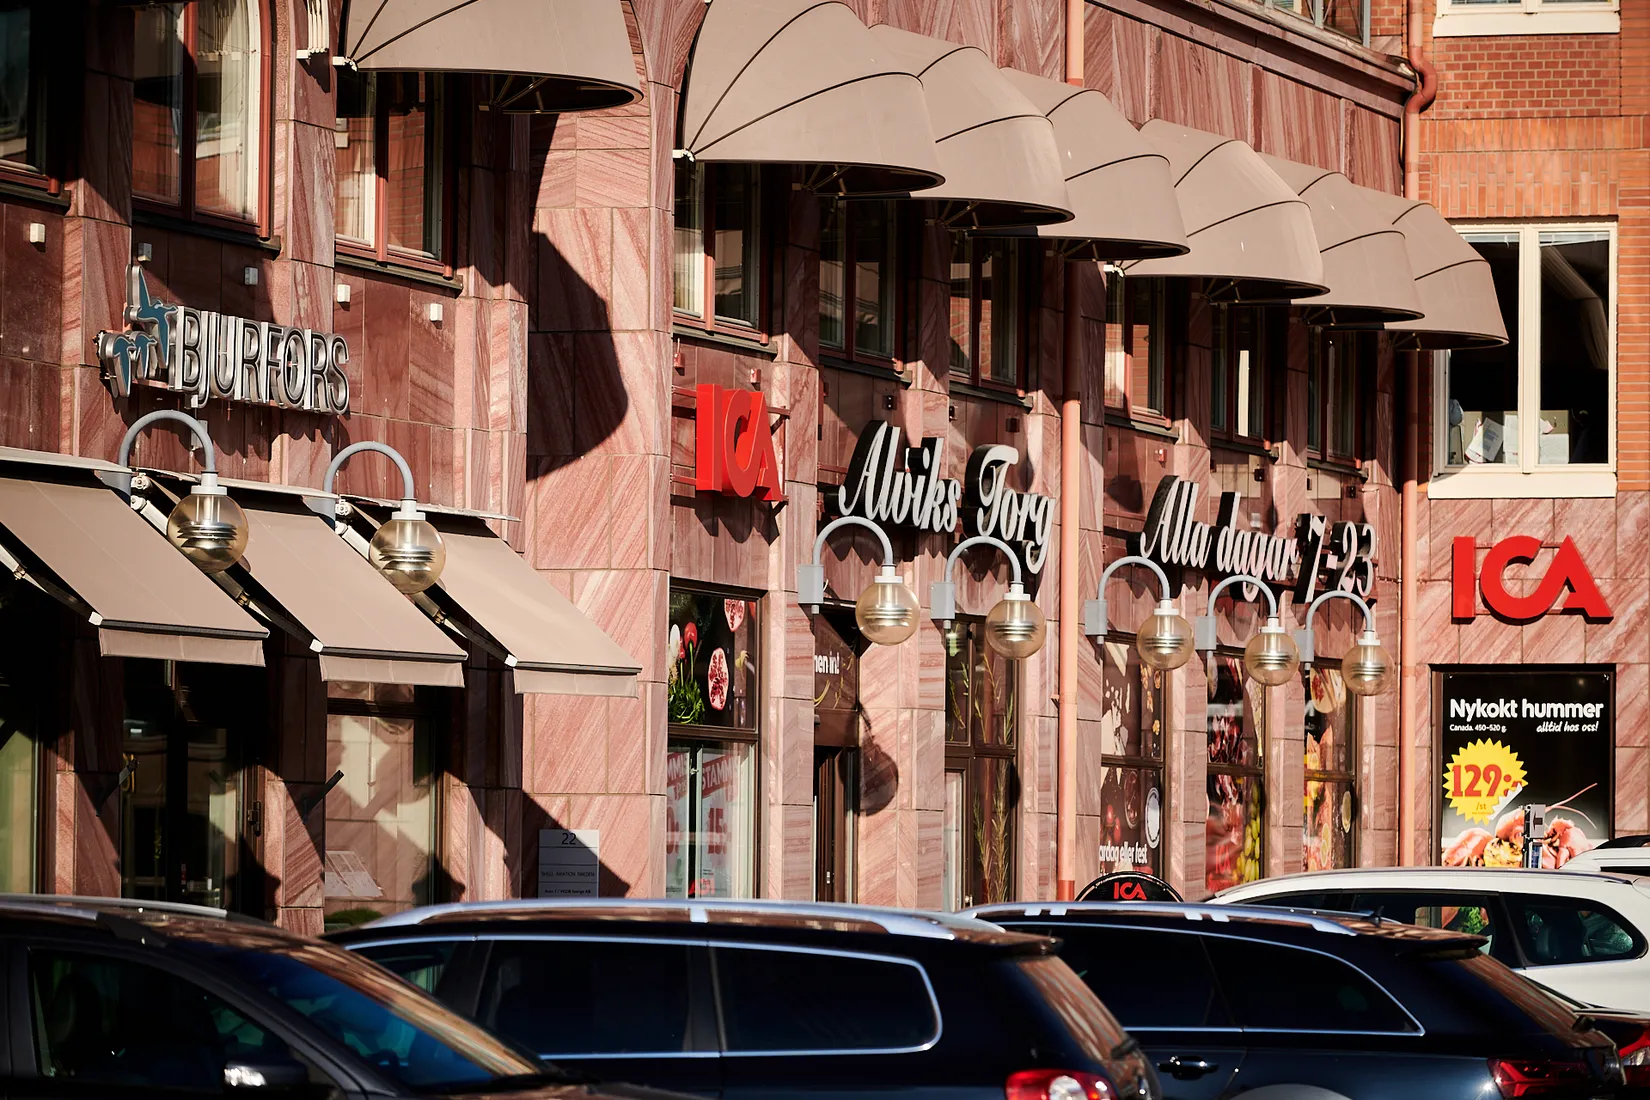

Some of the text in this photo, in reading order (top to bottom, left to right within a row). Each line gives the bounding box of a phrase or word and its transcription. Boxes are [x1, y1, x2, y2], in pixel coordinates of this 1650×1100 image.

[174, 306, 349, 414] BJURFORS
[696, 384, 783, 500] ICA
[836, 420, 1056, 574] Alviks Torg
[1139, 475, 1376, 603] Alla dagar 7-23
[1452, 535, 1613, 624] ICA
[1450, 698, 1604, 722] Nykokt hummer
[1536, 720, 1600, 733] alltid hos oss!
[561, 832, 577, 845] 22
[1120, 841, 1135, 863] eller
[1114, 882, 1147, 900] ICA
